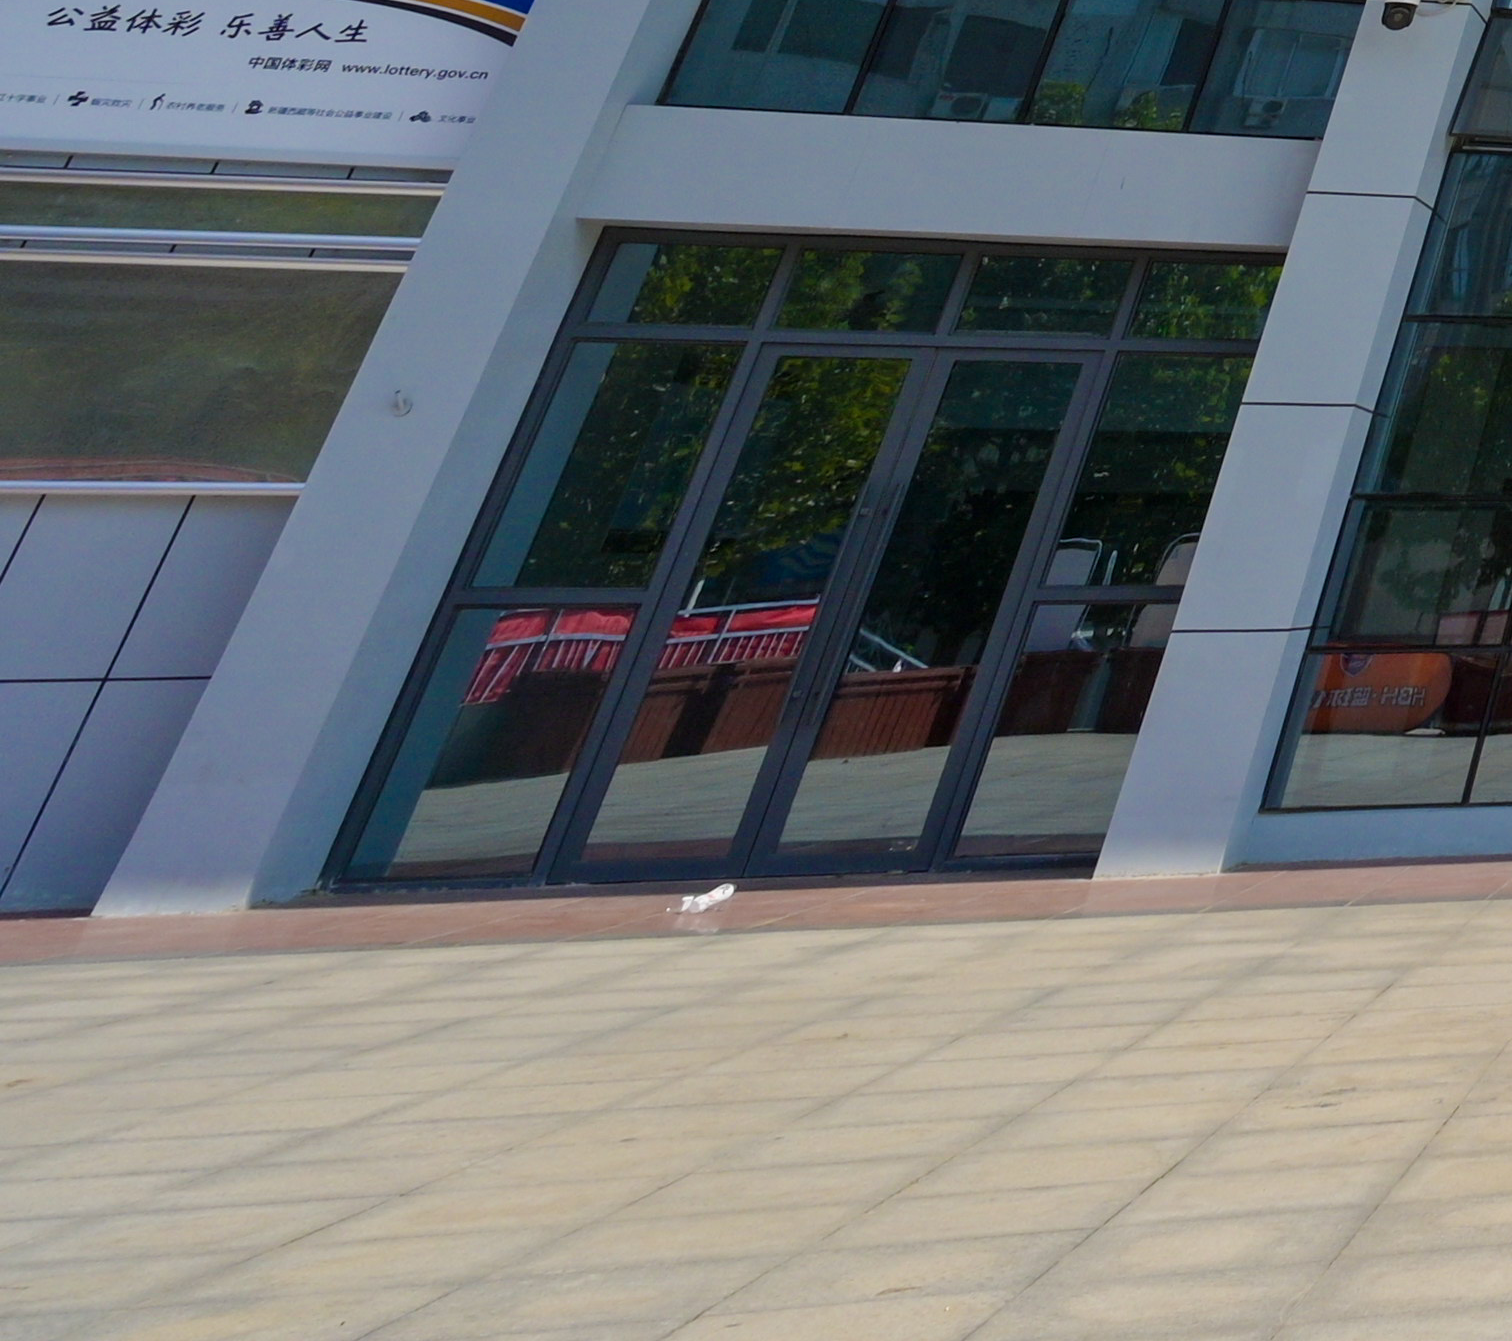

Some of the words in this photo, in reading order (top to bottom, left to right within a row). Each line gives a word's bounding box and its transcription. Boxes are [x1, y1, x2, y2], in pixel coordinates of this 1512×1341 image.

[47, 4, 206, 37] 公益体彩
[220, 13, 369, 44] 乐善人生
[248, 55, 333, 74] 中国体彩网
[341, 63, 490, 81] www.lottery.gov.cn
